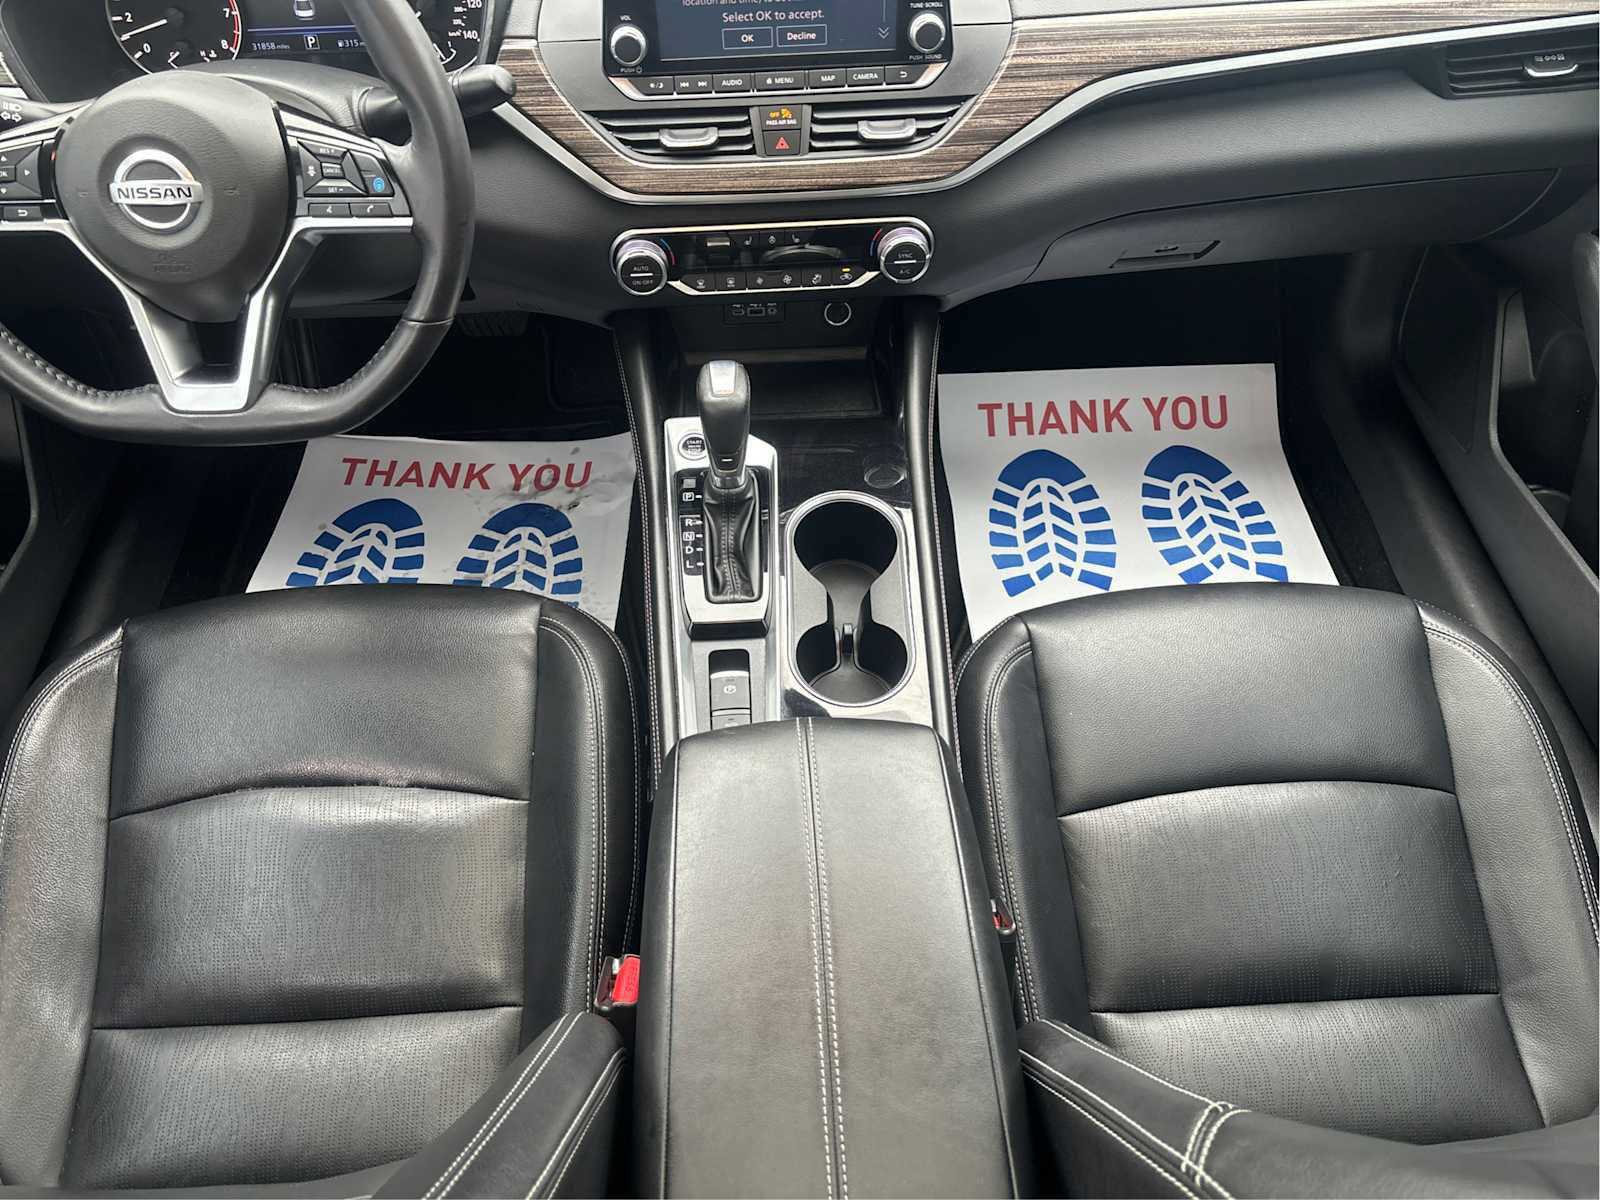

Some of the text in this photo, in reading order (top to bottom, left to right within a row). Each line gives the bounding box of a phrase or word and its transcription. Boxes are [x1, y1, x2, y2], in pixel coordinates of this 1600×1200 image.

[222, 8, 230, 18] 7
[722, 9, 825, 22] Select OK to accept.
[124, 13, 133, 23] 2
[463, 30, 478, 39] 140
[741, 34, 754, 43] OK
[787, 32, 817, 41] Decline
[221, 40, 229, 50] 8
[307, 36, 316, 48] P
[344, 39, 358, 47] 315
[143, 43, 151, 53] 0
[774, 77, 794, 85] MENU
[821, 74, 836, 82] MAP
[852, 73, 879, 81] CAMERA
[722, 79, 743, 87] AUDIO
[117, 185, 192, 200] NISSAN
[977, 395, 1228, 437] THANK YOU
[342, 458, 592, 492] THANK YOU
[685, 519, 693, 527] R
[685, 546, 694, 554] D
[686, 560, 694, 568] L
